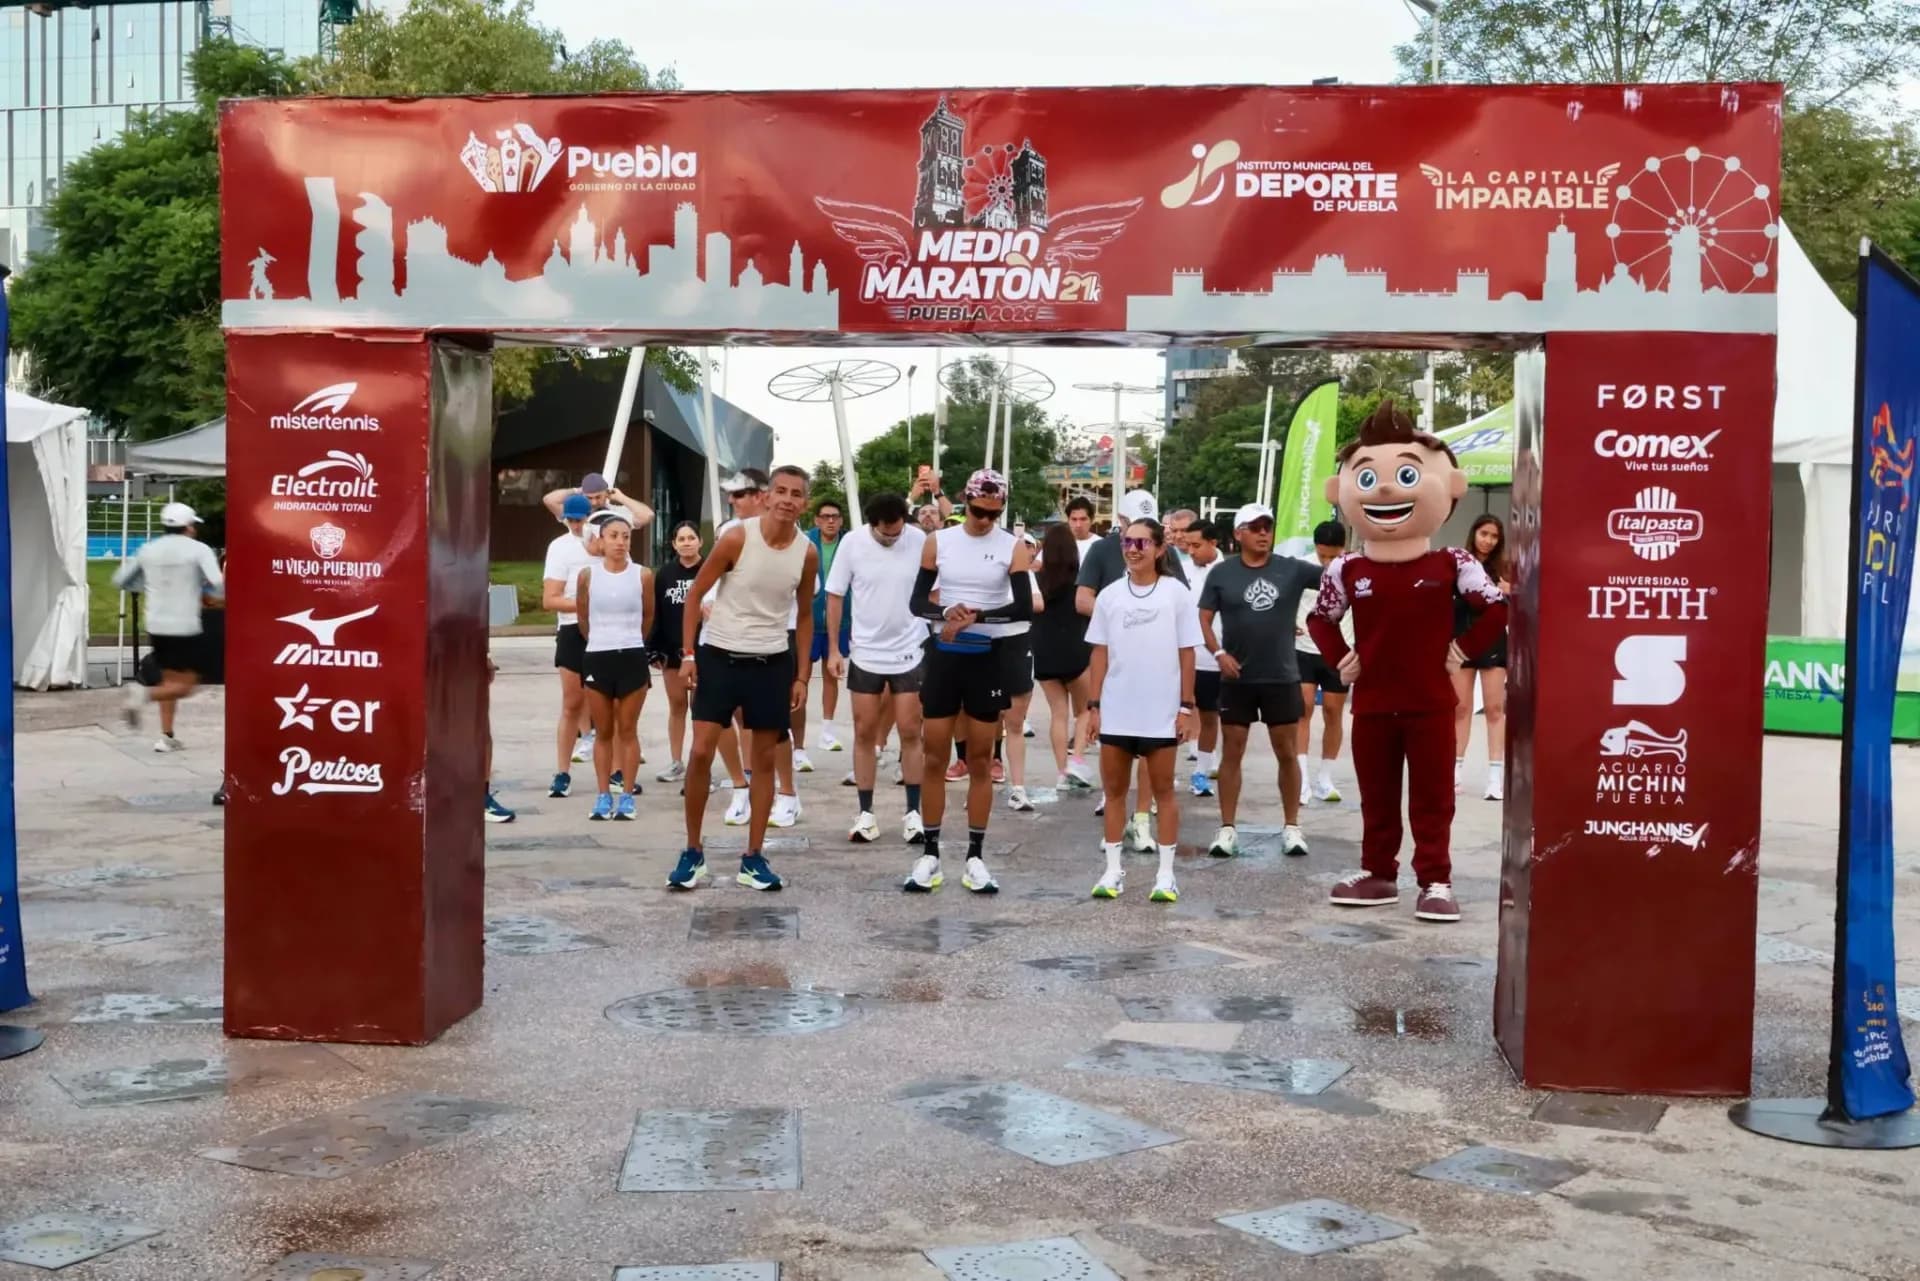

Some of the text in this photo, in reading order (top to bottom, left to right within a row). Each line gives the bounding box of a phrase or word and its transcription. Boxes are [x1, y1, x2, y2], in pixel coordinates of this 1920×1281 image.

[567, 144, 697, 178] Puebla
[1236, 161, 1373, 171] INSTITUTO MUNICIPAL DEL
[569, 182, 696, 191] GOBIERNO DE LA CIUDAD
[1235, 172, 1398, 198] DEPORTE
[1447, 171, 1594, 185] LA CAPITAL
[1313, 200, 1398, 212] DE PUEBLA
[1436, 187, 1609, 209] IMPARABLE
[917, 230, 1040, 262] MEDIO
[908, 306, 988, 321] PUEBLA
[270, 413, 380, 432] mistertennis
[1594, 429, 1722, 459] Comex
[1625, 461, 1709, 472] Vive tus sueños
[271, 475, 379, 498] Electrolit
[1618, 514, 1694, 534] italpasta
[286, 558, 319, 578] VIEJO
[323, 560, 382, 579] PUEBLITO
[1608, 575, 1689, 586] UNIVERSIDAD
[1587, 586, 1708, 620] IPETH
[271, 746, 384, 795] Pericos
[1597, 762, 1686, 775] ACUARIO
[1597, 774, 1686, 793] MICHIN
[1596, 791, 1684, 805] PUEBLA
[1584, 820, 1694, 838] JUNGHANNS
